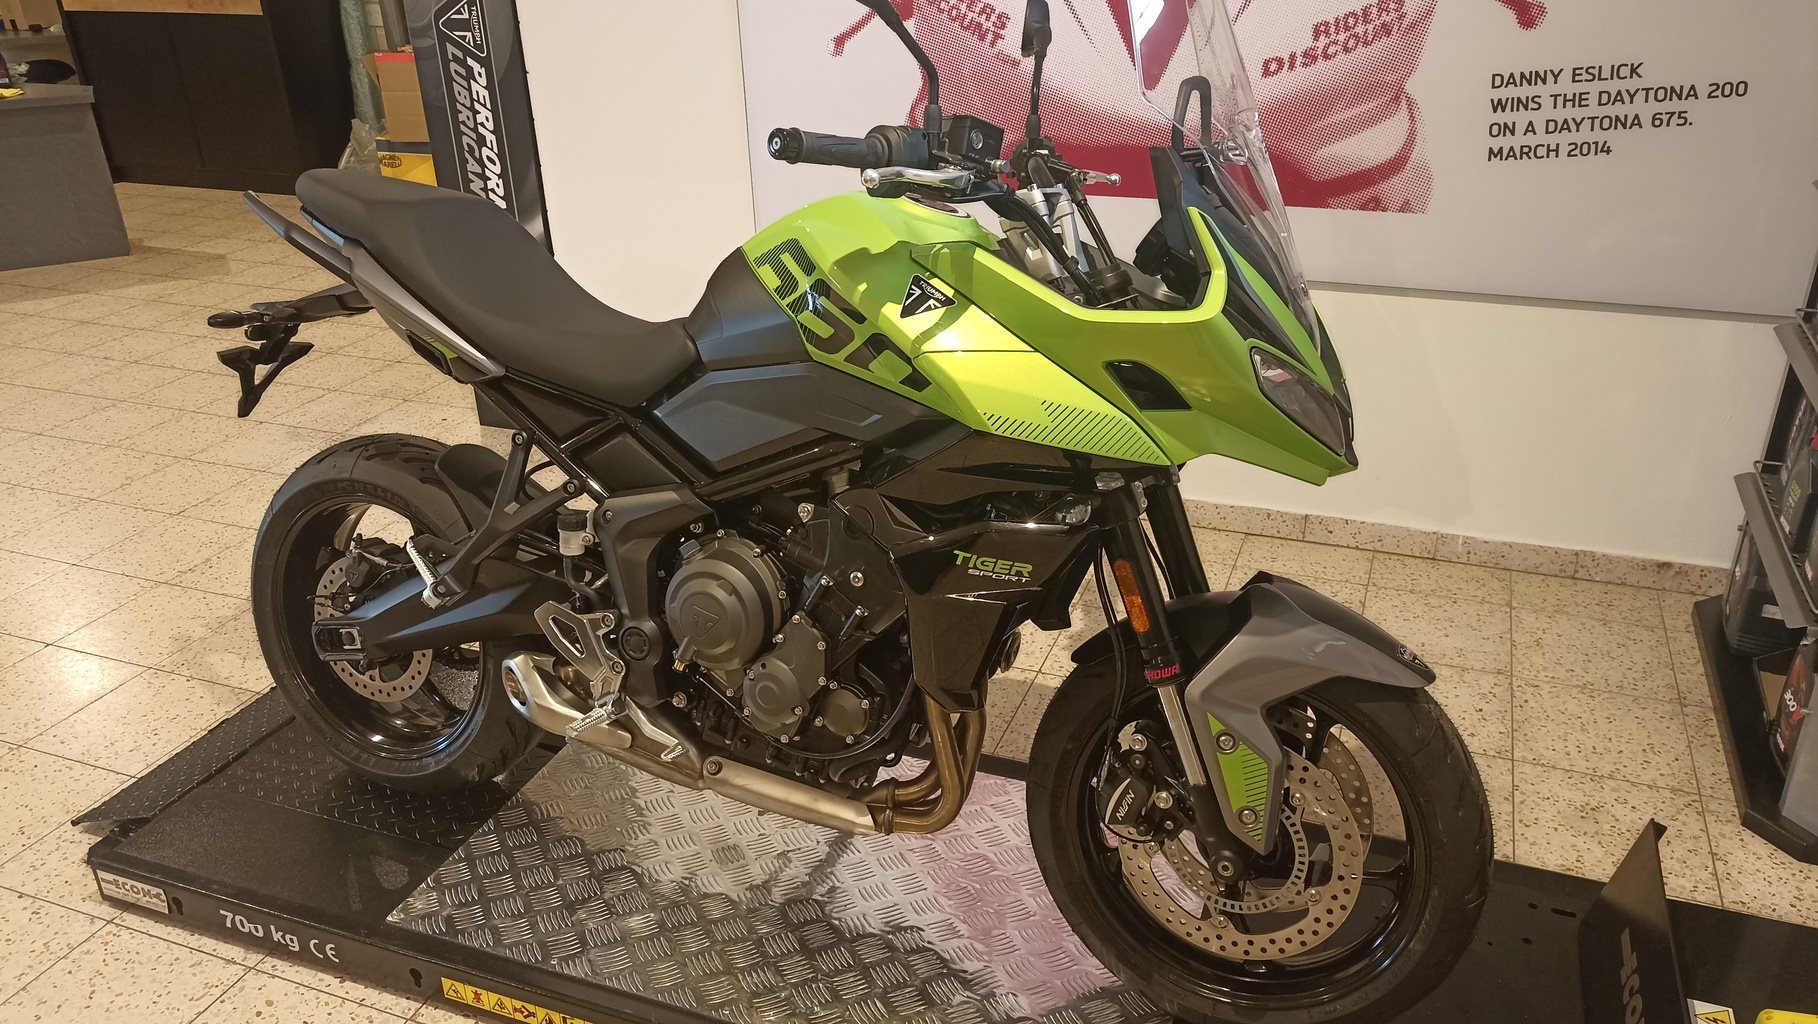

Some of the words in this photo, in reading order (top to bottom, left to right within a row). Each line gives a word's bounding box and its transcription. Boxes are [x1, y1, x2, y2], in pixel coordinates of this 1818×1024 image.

[470, 5, 482, 44] TRIUMPH
[1491, 68, 1565, 90] DANNY
[1571, 62, 1645, 84] ESLICK
[1490, 94, 1543, 114] WINS
[1549, 91, 1591, 110] THE
[1597, 84, 1700, 108] DAYTONA
[1706, 80, 1749, 100] 200
[1488, 121, 1517, 138] ON
[1523, 120, 1538, 136] A
[1544, 113, 1644, 135] DAYTONA
[1650, 110, 1694, 129] 675.
[1487, 142, 1561, 162] MARCH
[1566, 140, 1613, 158] 2014
[919, 280, 947, 302] TRIUMPH
[953, 549, 1033, 578] TIGER
[967, 568, 1032, 583] SPORT
[220, 909, 265, 938] 700
[270, 925, 300, 952] kg
